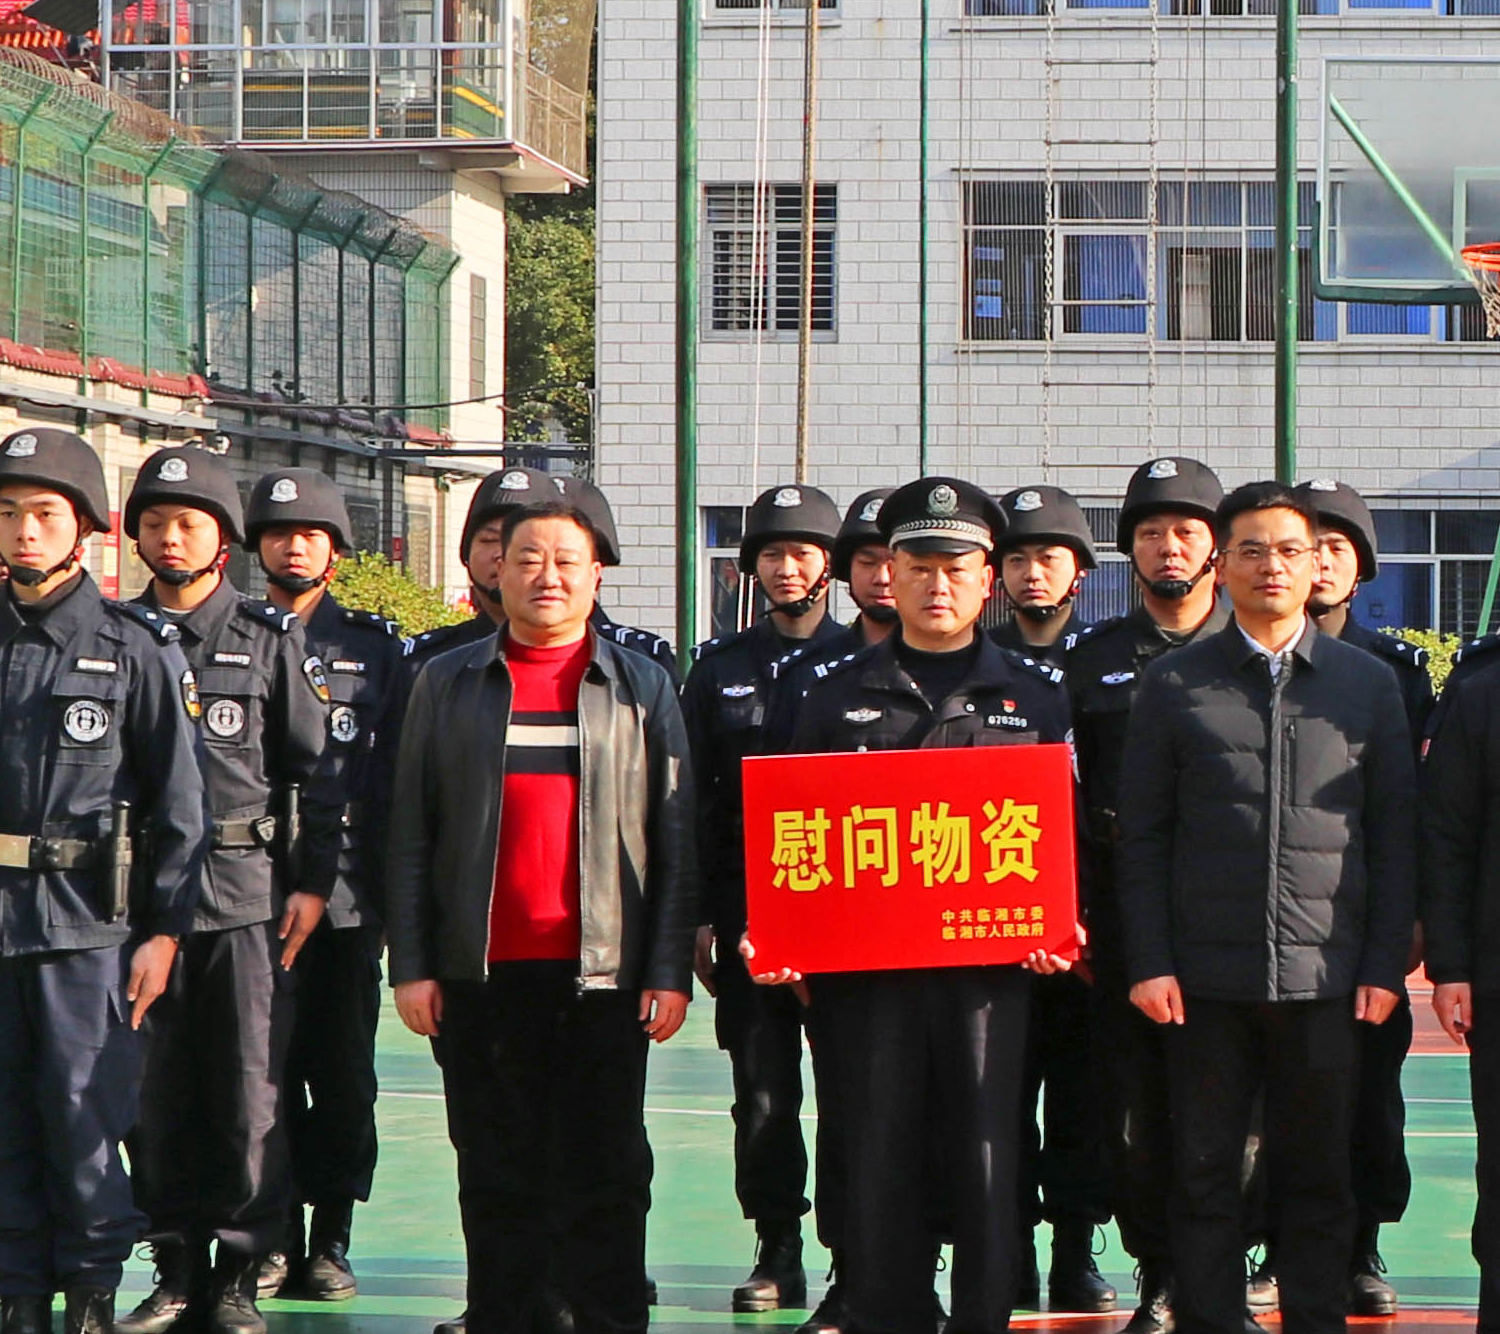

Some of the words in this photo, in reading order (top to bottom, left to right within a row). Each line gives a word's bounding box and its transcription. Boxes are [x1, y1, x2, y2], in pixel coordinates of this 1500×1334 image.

[770, 797, 1043, 892] 慰问物资
[941, 906, 1044, 923] 中共临湘市委
[941, 921, 1045, 941] 临湘市人民政府
